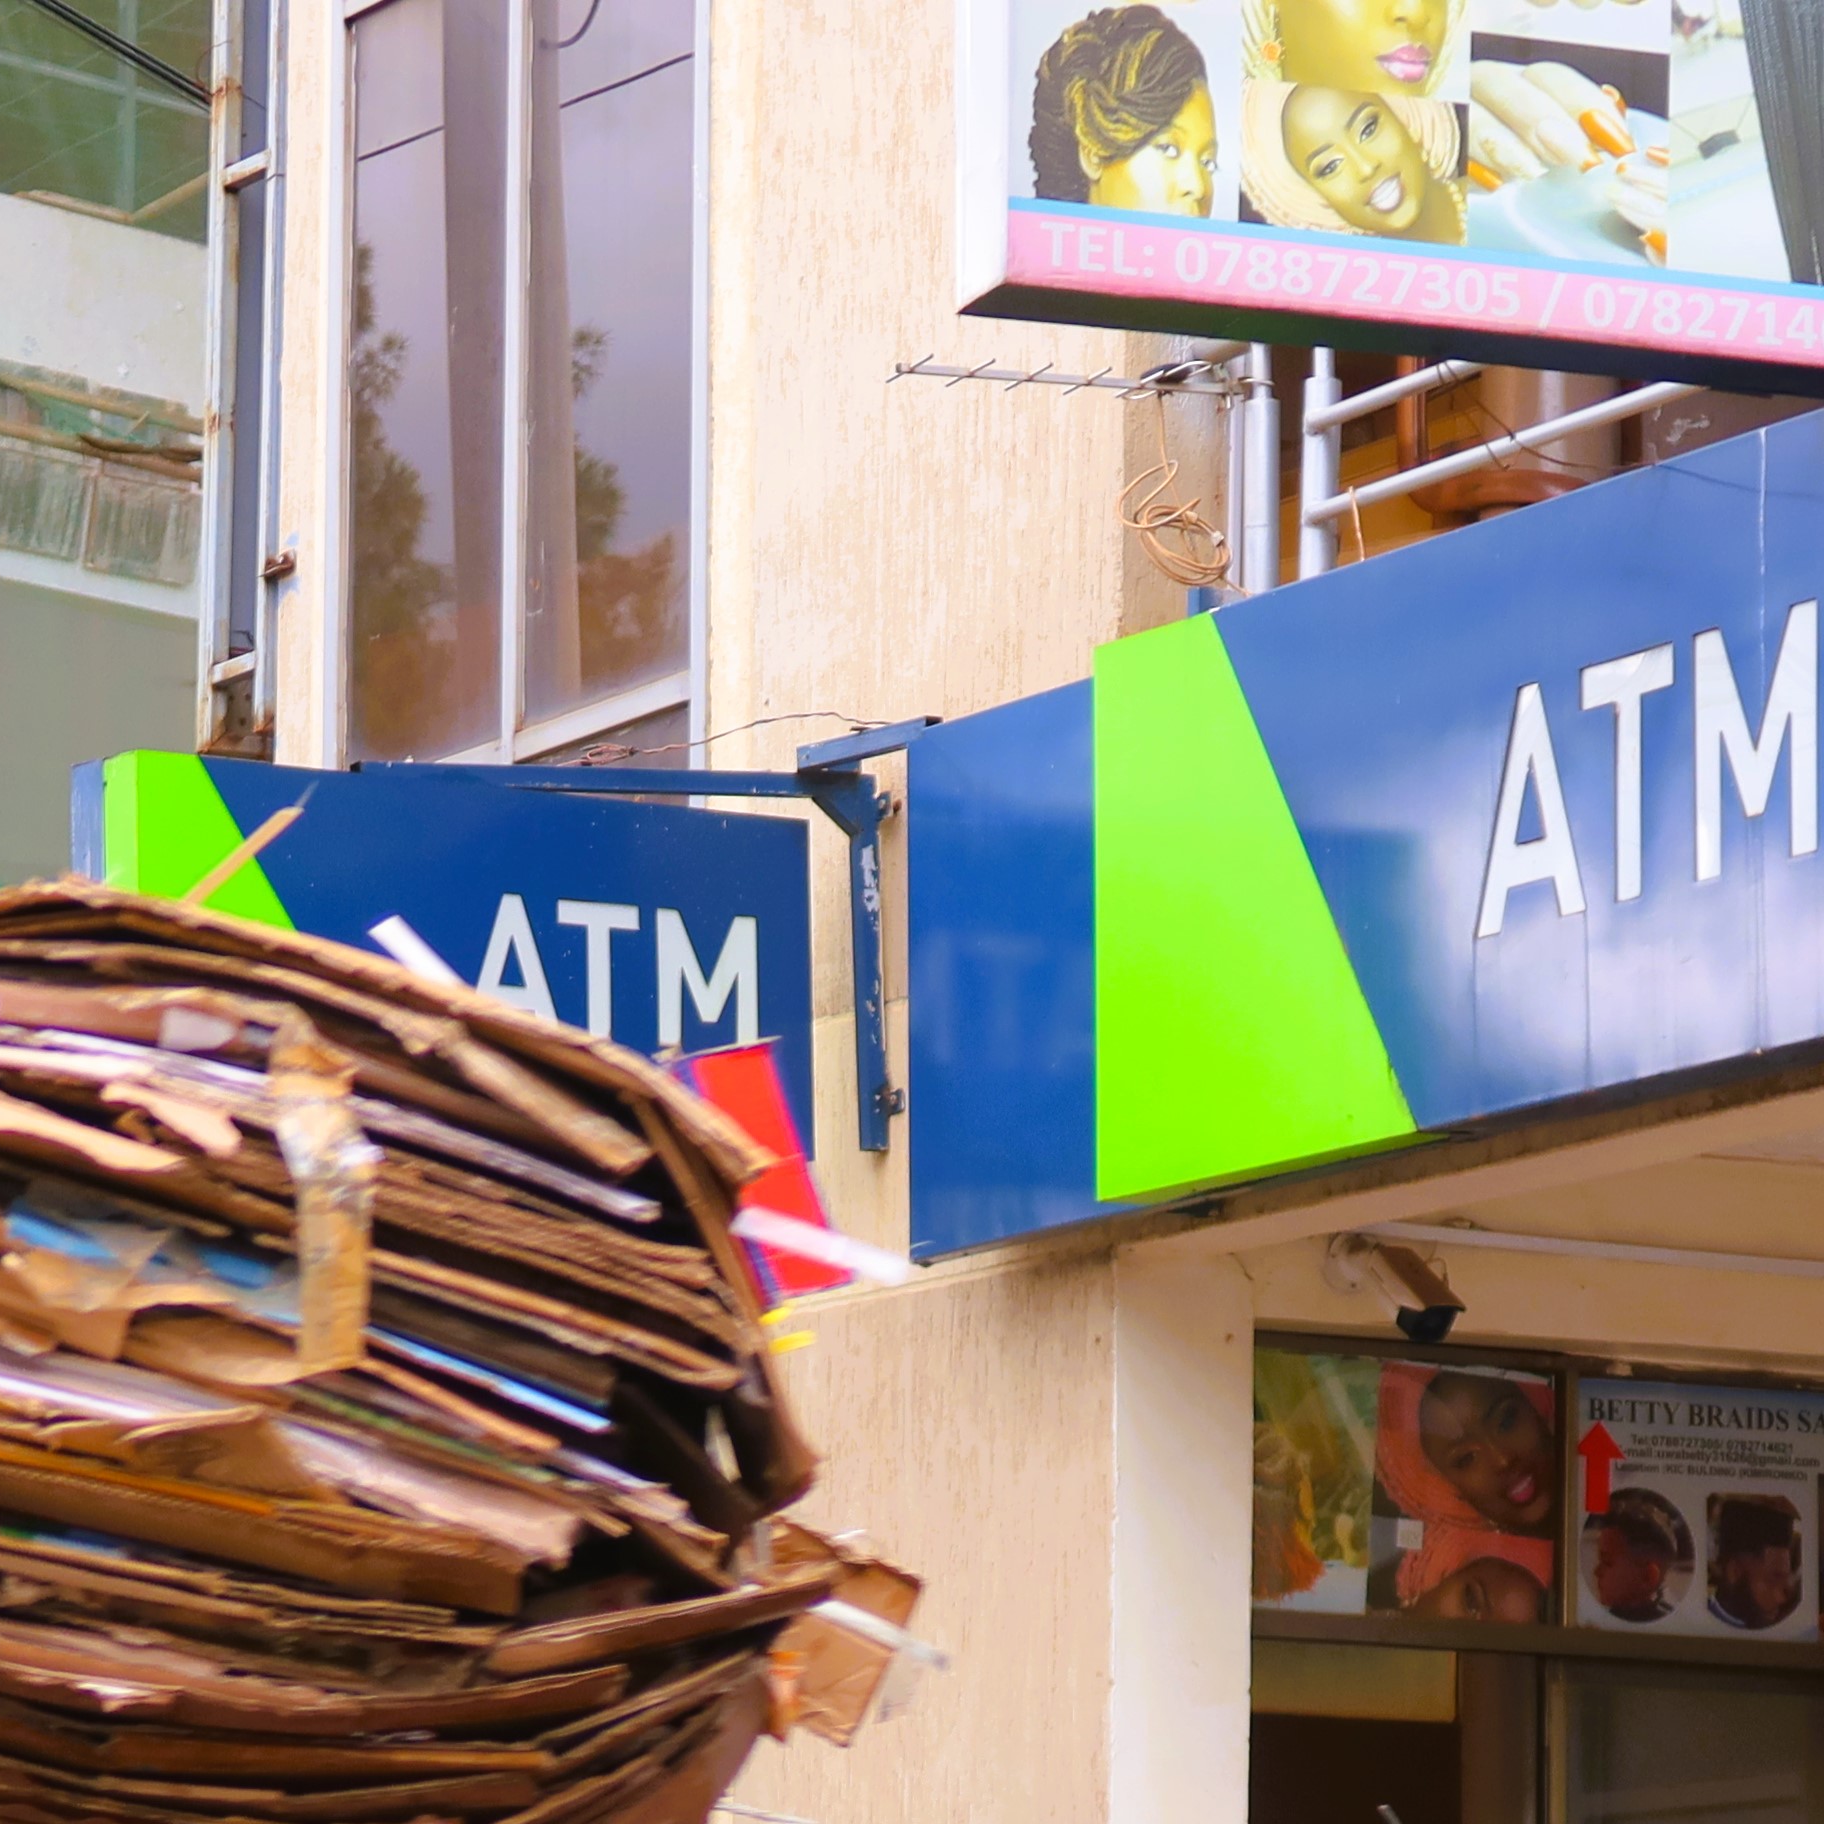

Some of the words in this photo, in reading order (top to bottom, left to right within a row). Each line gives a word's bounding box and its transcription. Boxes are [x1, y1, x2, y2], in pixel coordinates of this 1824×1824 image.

[1040, 220, 1155, 279] TEL:
[1174, 236, 1521, 318] 0788727305
[1537, 272, 1566, 331] /
[1475, 596, 1819, 940] ATM
[475, 892, 760, 1047] ATM
[1588, 1397, 1685, 1425] BETTY
[1688, 1403, 1790, 1433] BRAIDS
